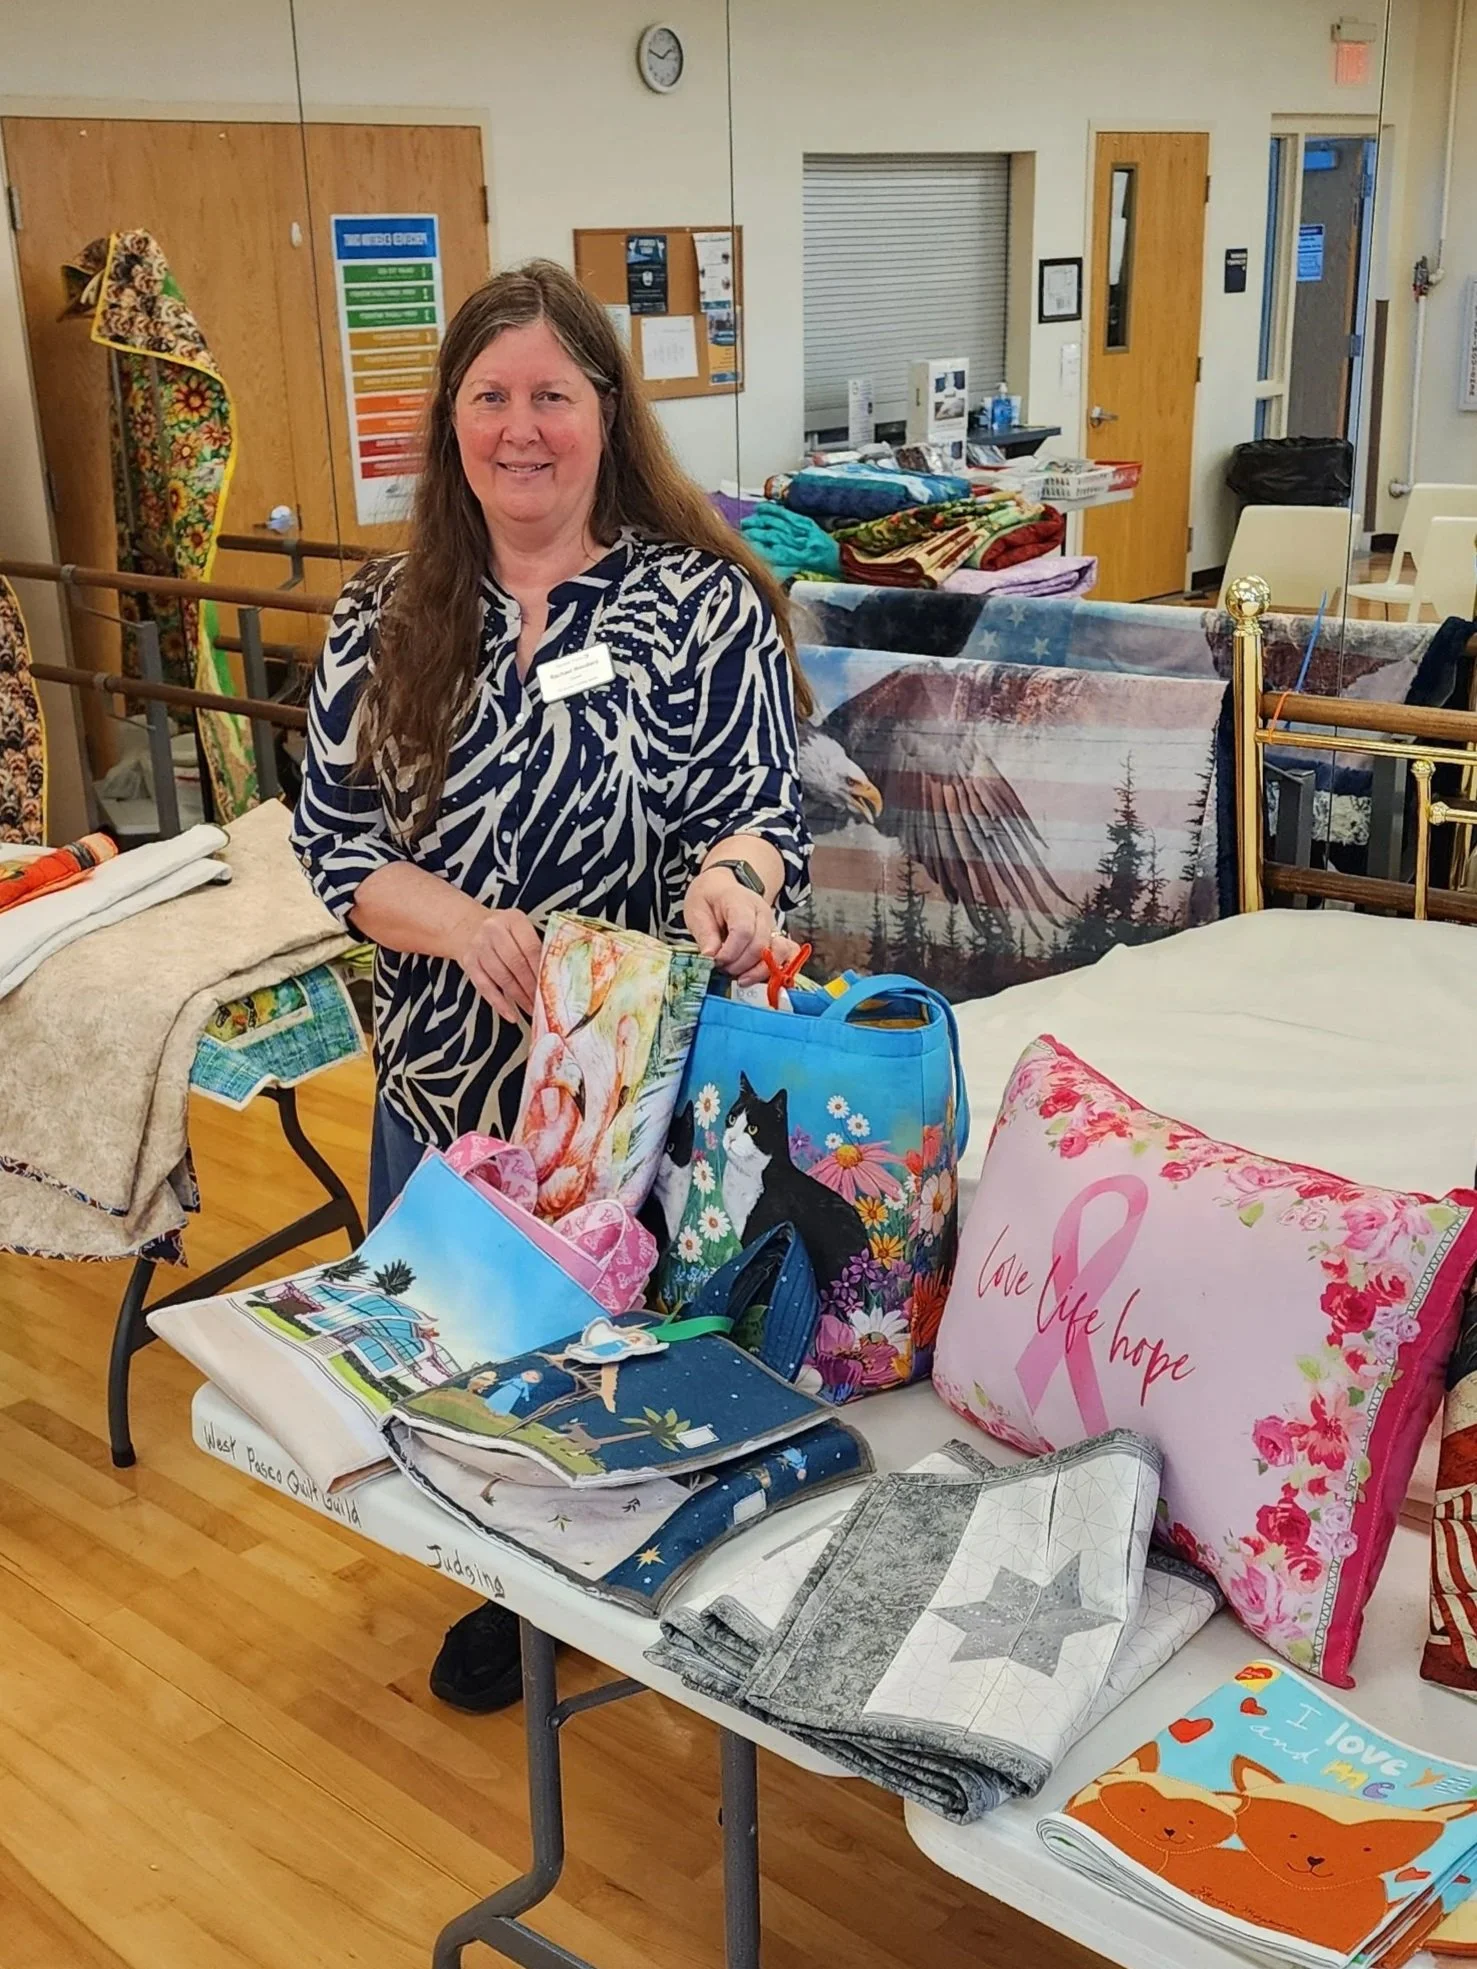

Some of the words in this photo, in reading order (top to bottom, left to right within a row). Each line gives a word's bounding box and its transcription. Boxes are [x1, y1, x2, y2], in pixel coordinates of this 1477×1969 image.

[1108, 1287, 1196, 1408] hope
[203, 1421, 237, 1460] West
[246, 1445, 283, 1485] Pasco
[286, 1468, 319, 1501] Quilt
[426, 1544, 506, 1599] Judging
[1249, 1723, 1320, 1765] and
[1319, 1759, 1396, 1799] me
[1285, 1702, 1323, 1731] I
[1324, 1721, 1408, 1777] love
